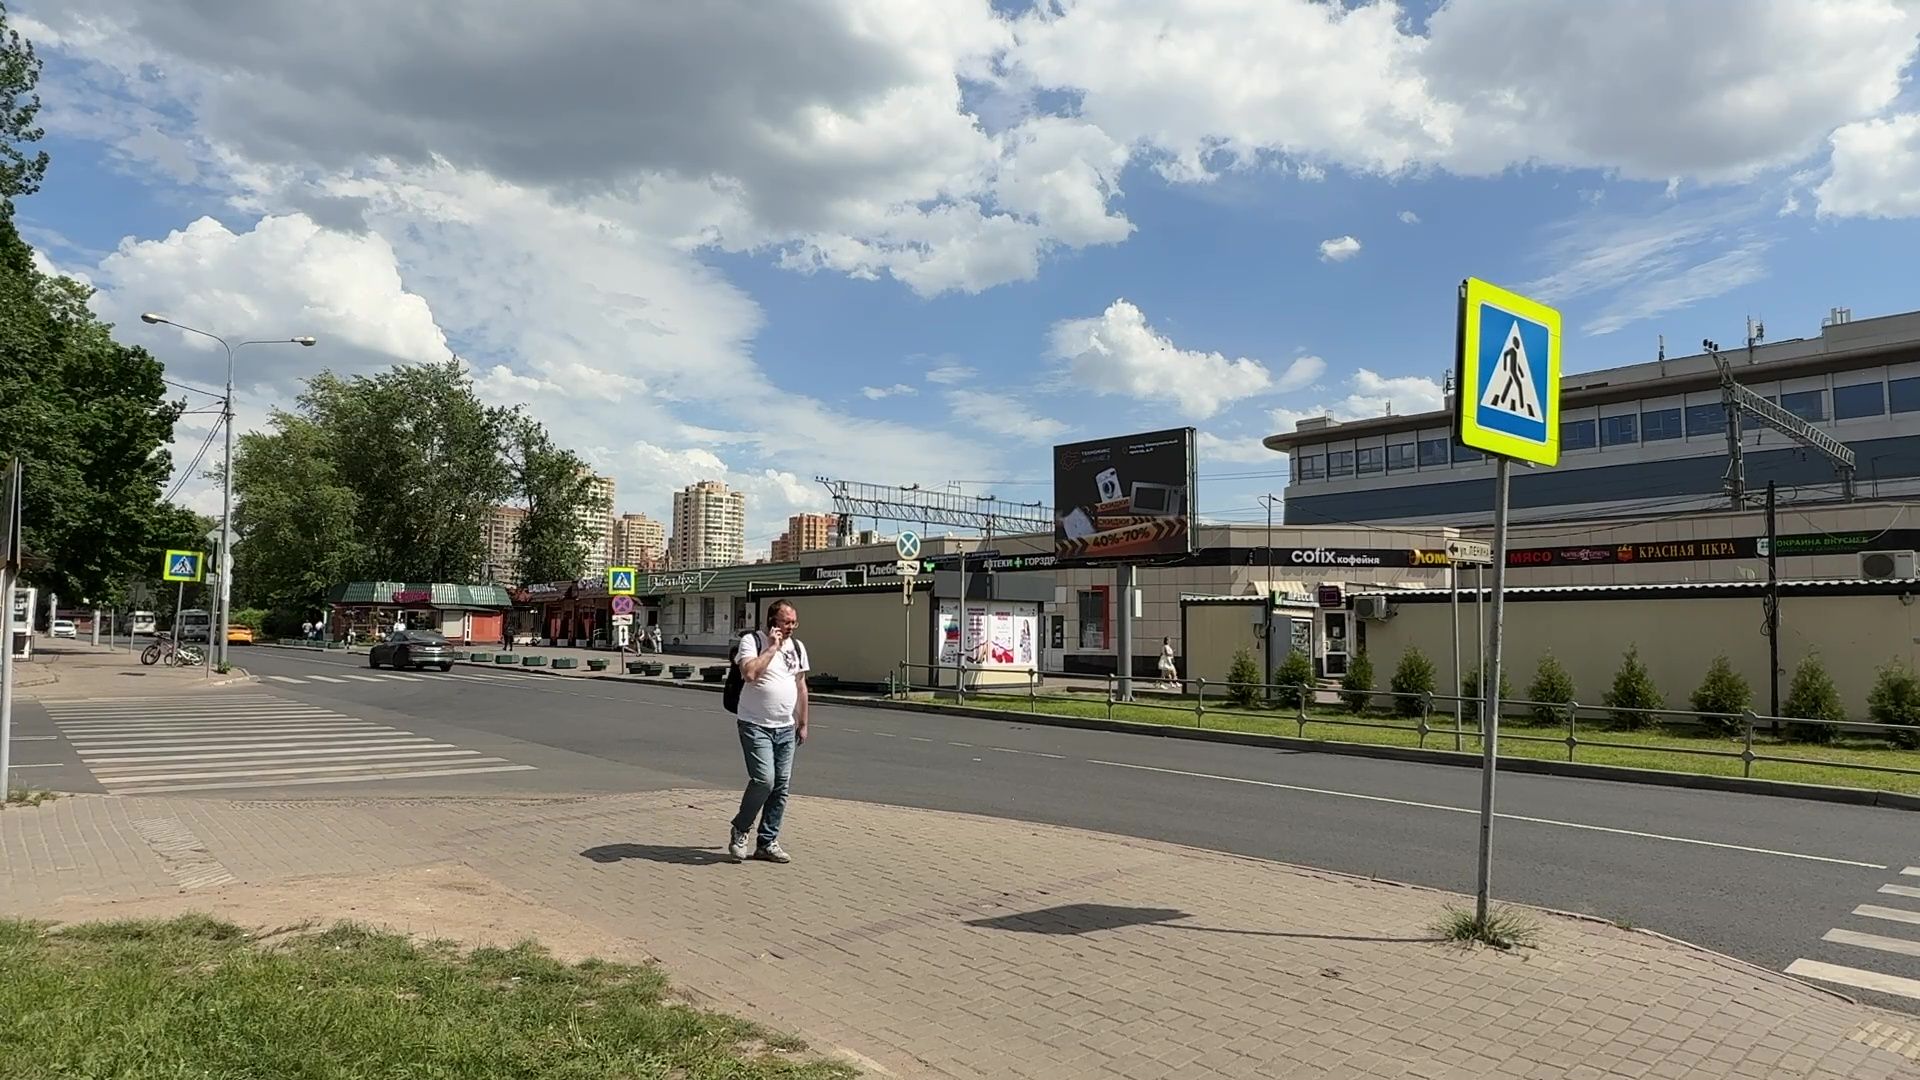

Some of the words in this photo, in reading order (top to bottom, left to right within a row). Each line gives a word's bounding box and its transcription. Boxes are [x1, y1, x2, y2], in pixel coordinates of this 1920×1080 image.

[1092, 527, 1150, 547] 40%-70%
[1776, 538, 1822, 547] ОКРАИНА
[1292, 548, 1336, 564] cofix
[1510, 551, 1552, 564] МЯСО
[1639, 545, 1694, 559] КРАСНАЯ
[1702, 543, 1736, 555] ИКРА
[1337, 555, 1380, 566] кофейня
